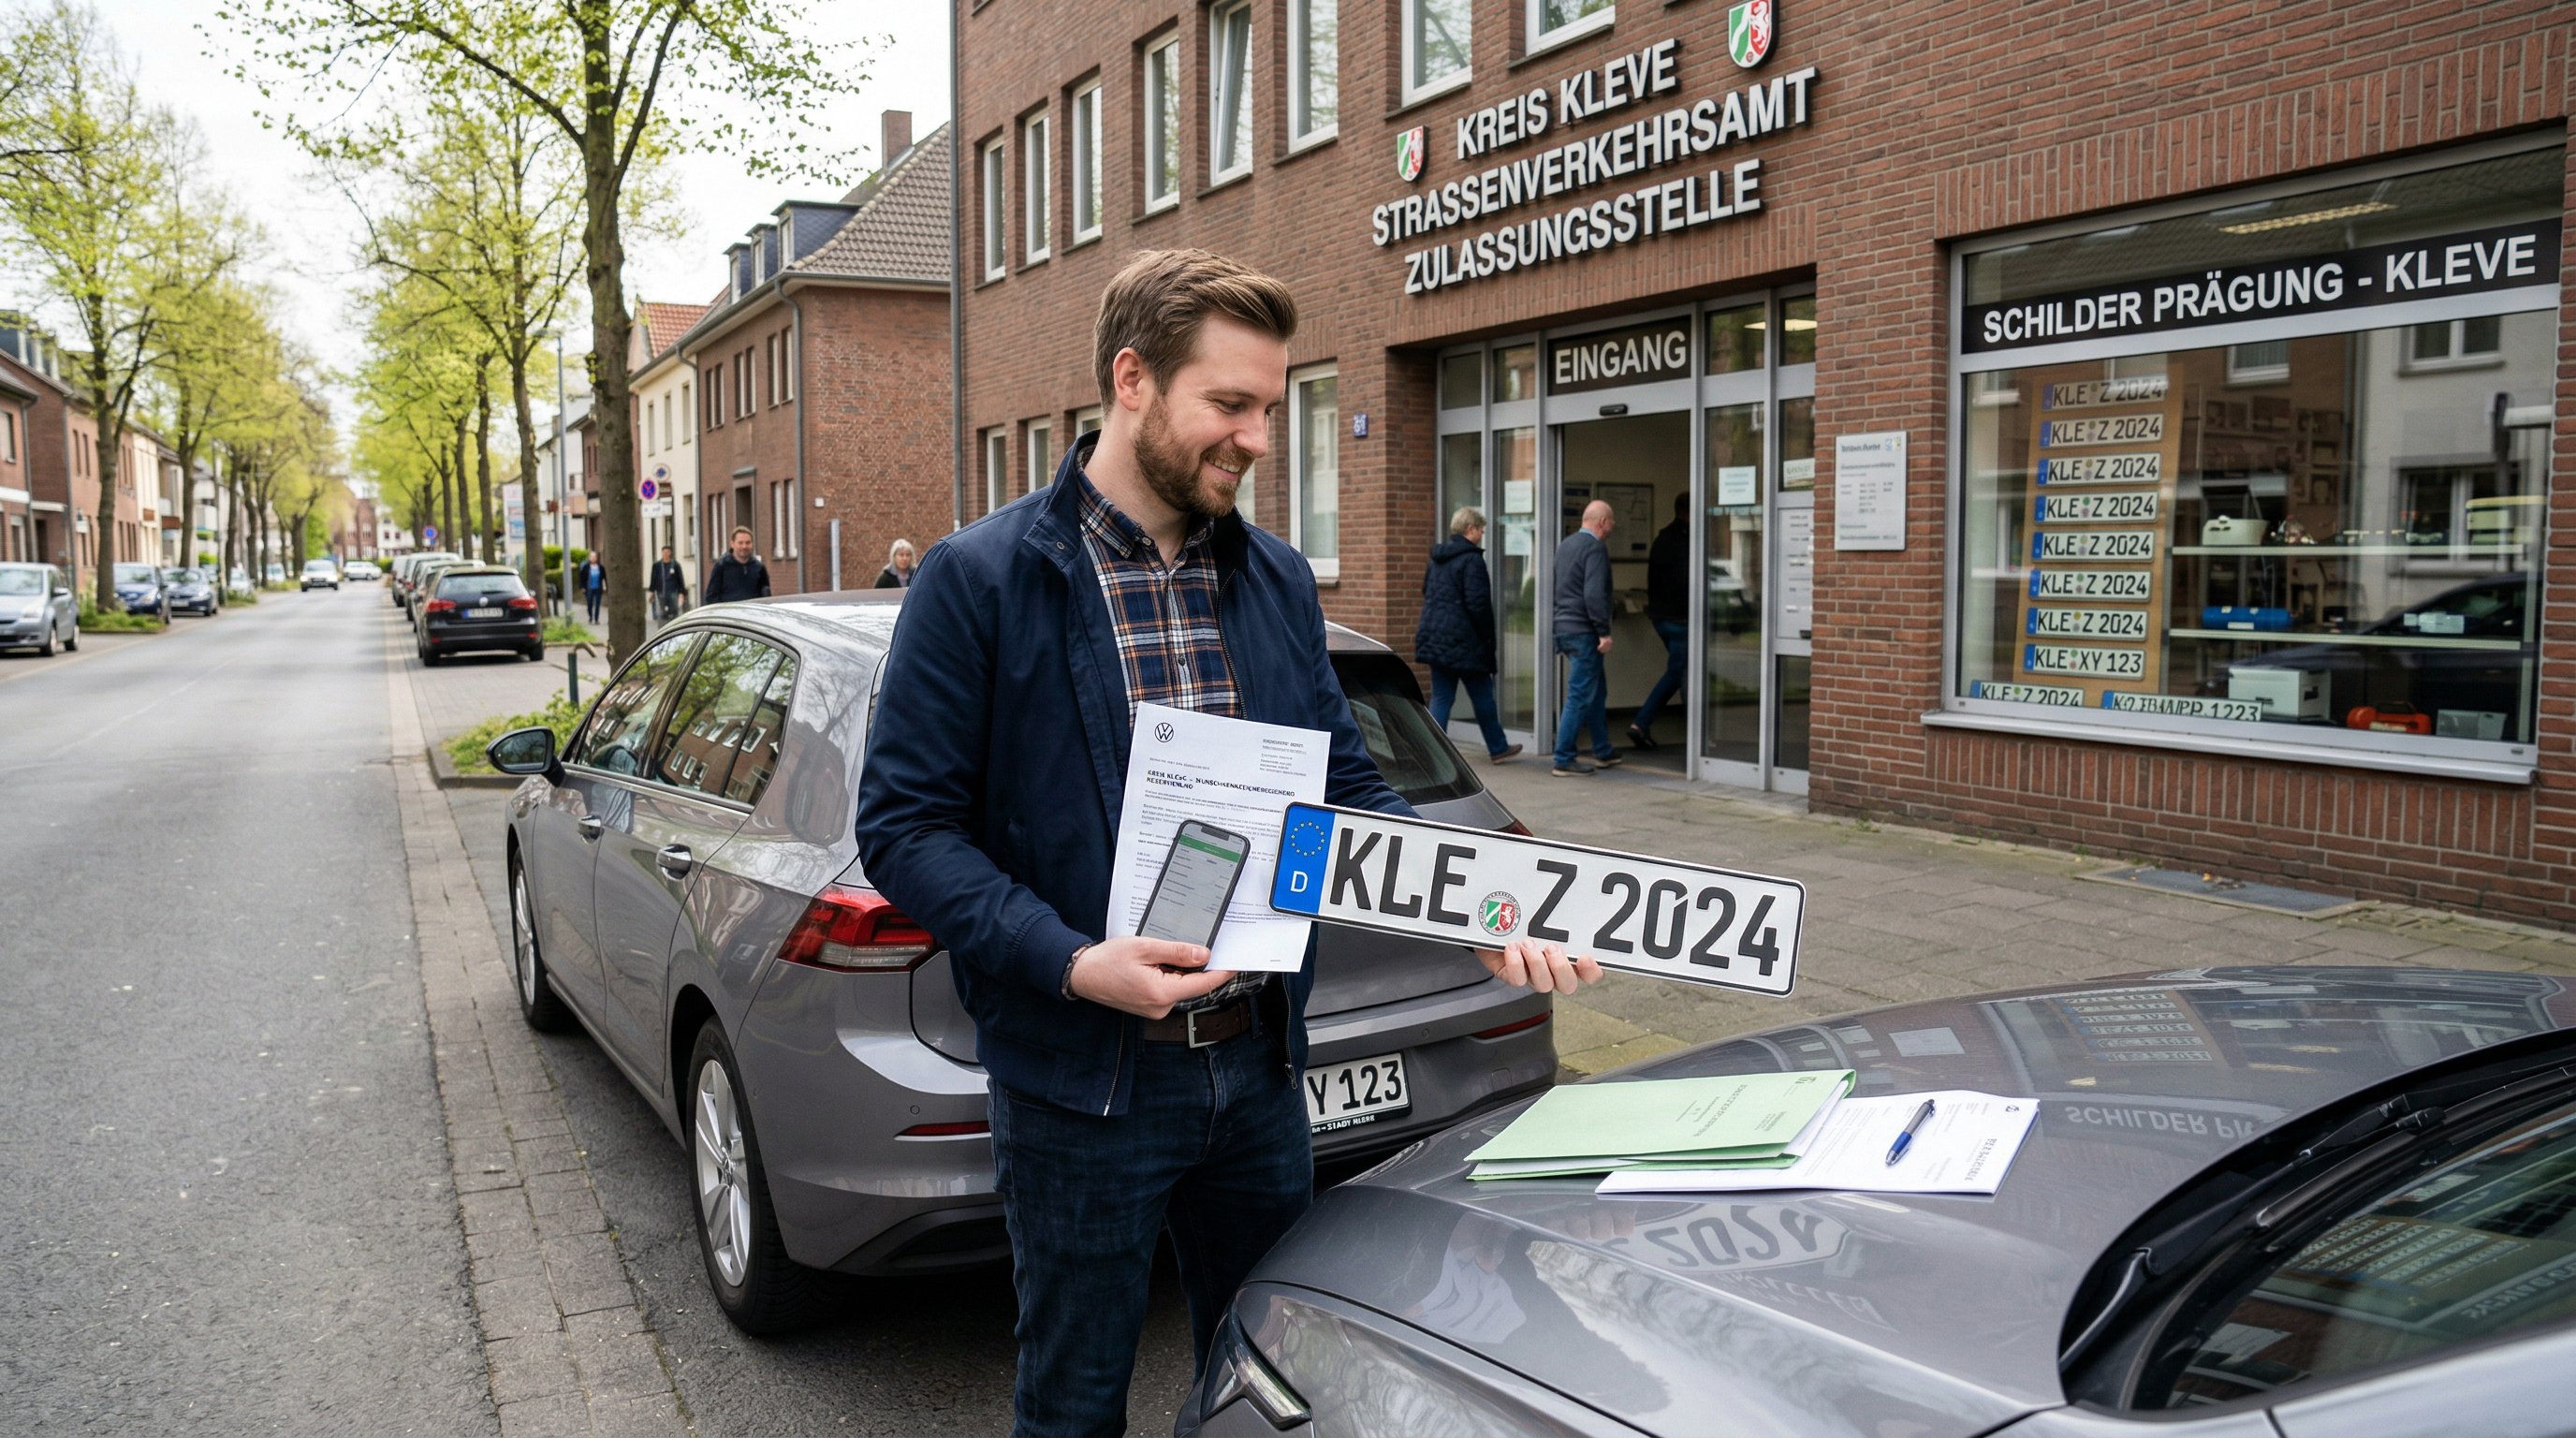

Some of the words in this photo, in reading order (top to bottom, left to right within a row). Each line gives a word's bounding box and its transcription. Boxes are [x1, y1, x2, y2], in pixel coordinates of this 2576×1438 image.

[1457, 88, 1549, 160] KREIS
[1559, 38, 1677, 125] KLEVE
[1372, 66, 1816, 247] STRASSENVERKEHRSAMT
[1405, 158, 1762, 295] ZULASSUNGSSTELLE
[1983, 291, 2143, 344] SCHILDER
[2154, 262, 2344, 323] PRÄGUNG
[2358, 276, 2372, 287] -
[2385, 234, 2537, 293] KLEVE
[1556, 330, 1686, 385] EINGANG
[2054, 385, 2087, 406] KLE
[2100, 382, 2111, 403] Z
[2115, 378, 2162, 402] 2024
[2051, 422, 2085, 444] KLE
[2098, 420, 2109, 440] Z
[2114, 417, 2159, 439] 2024
[2048, 460, 2082, 480] KLE
[2094, 459, 2106, 479] Z
[2111, 456, 2157, 478] 2024
[2046, 498, 2079, 518] KLE
[2092, 497, 2103, 517] Z
[2108, 495, 2154, 517] 2024
[2043, 536, 2077, 555] KLE
[2088, 536, 2100, 555] Z
[2105, 535, 2150, 556] 2024
[2041, 574, 2073, 594] KLE
[2086, 574, 2097, 594] Z
[2101, 575, 2146, 595] 2024
[2037, 611, 2071, 632] KLE
[2082, 613, 2094, 633] Z
[2099, 613, 2144, 635] 2024
[2035, 649, 2068, 668] KLE
[2078, 651, 2102, 671] XY
[2106, 653, 2142, 673] 123
[1290, 871, 1308, 893] D
[1329, 828, 1477, 927] KLE
[1527, 858, 1577, 943] Z
[1593, 872, 1780, 976] 2024
[1307, 1073, 1327, 1115] Y
[1339, 1060, 1402, 1111] 123
